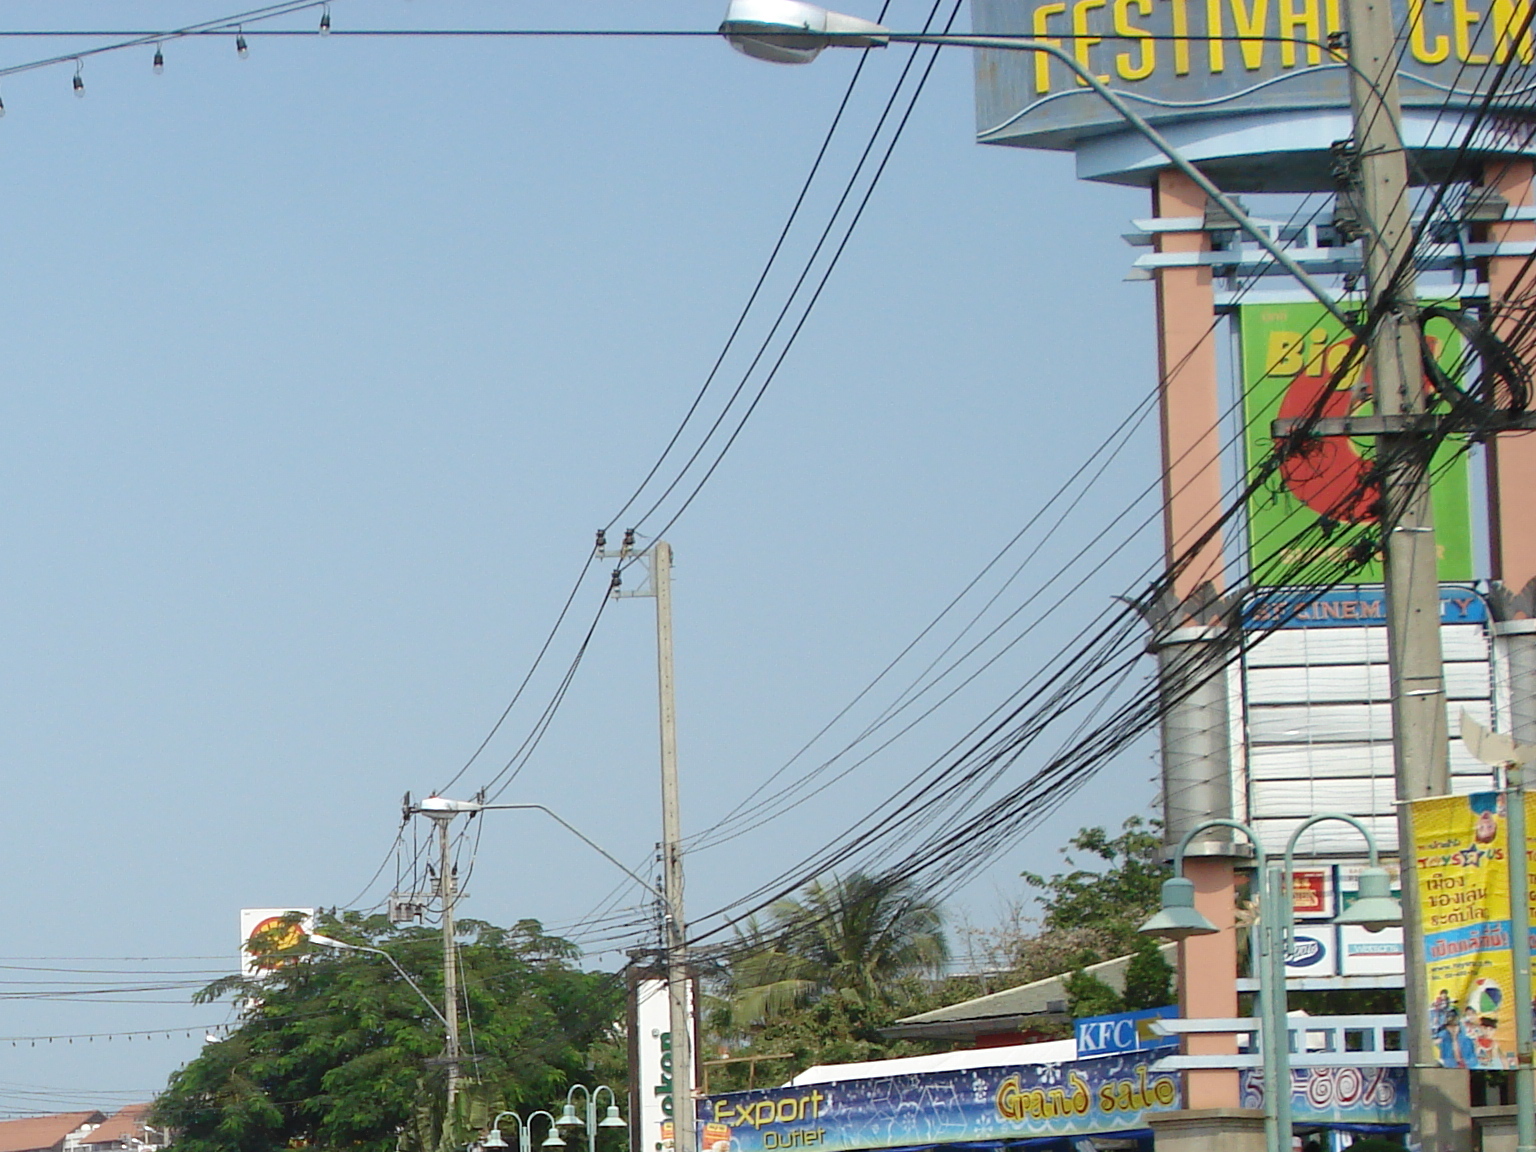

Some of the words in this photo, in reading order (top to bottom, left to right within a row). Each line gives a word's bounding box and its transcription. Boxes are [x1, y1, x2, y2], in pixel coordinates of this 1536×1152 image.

[1265, 327, 1369, 390] Big
[1294, 600, 1387, 621] CINEM
[1426, 873, 1465, 891] เมือง
[1078, 1018, 1135, 1052] KFC
[996, 1071, 1091, 1122] Grand
[1097, 1060, 1176, 1113] sale
[715, 1089, 824, 1130] Export
[764, 1127, 826, 1150] Outlet
